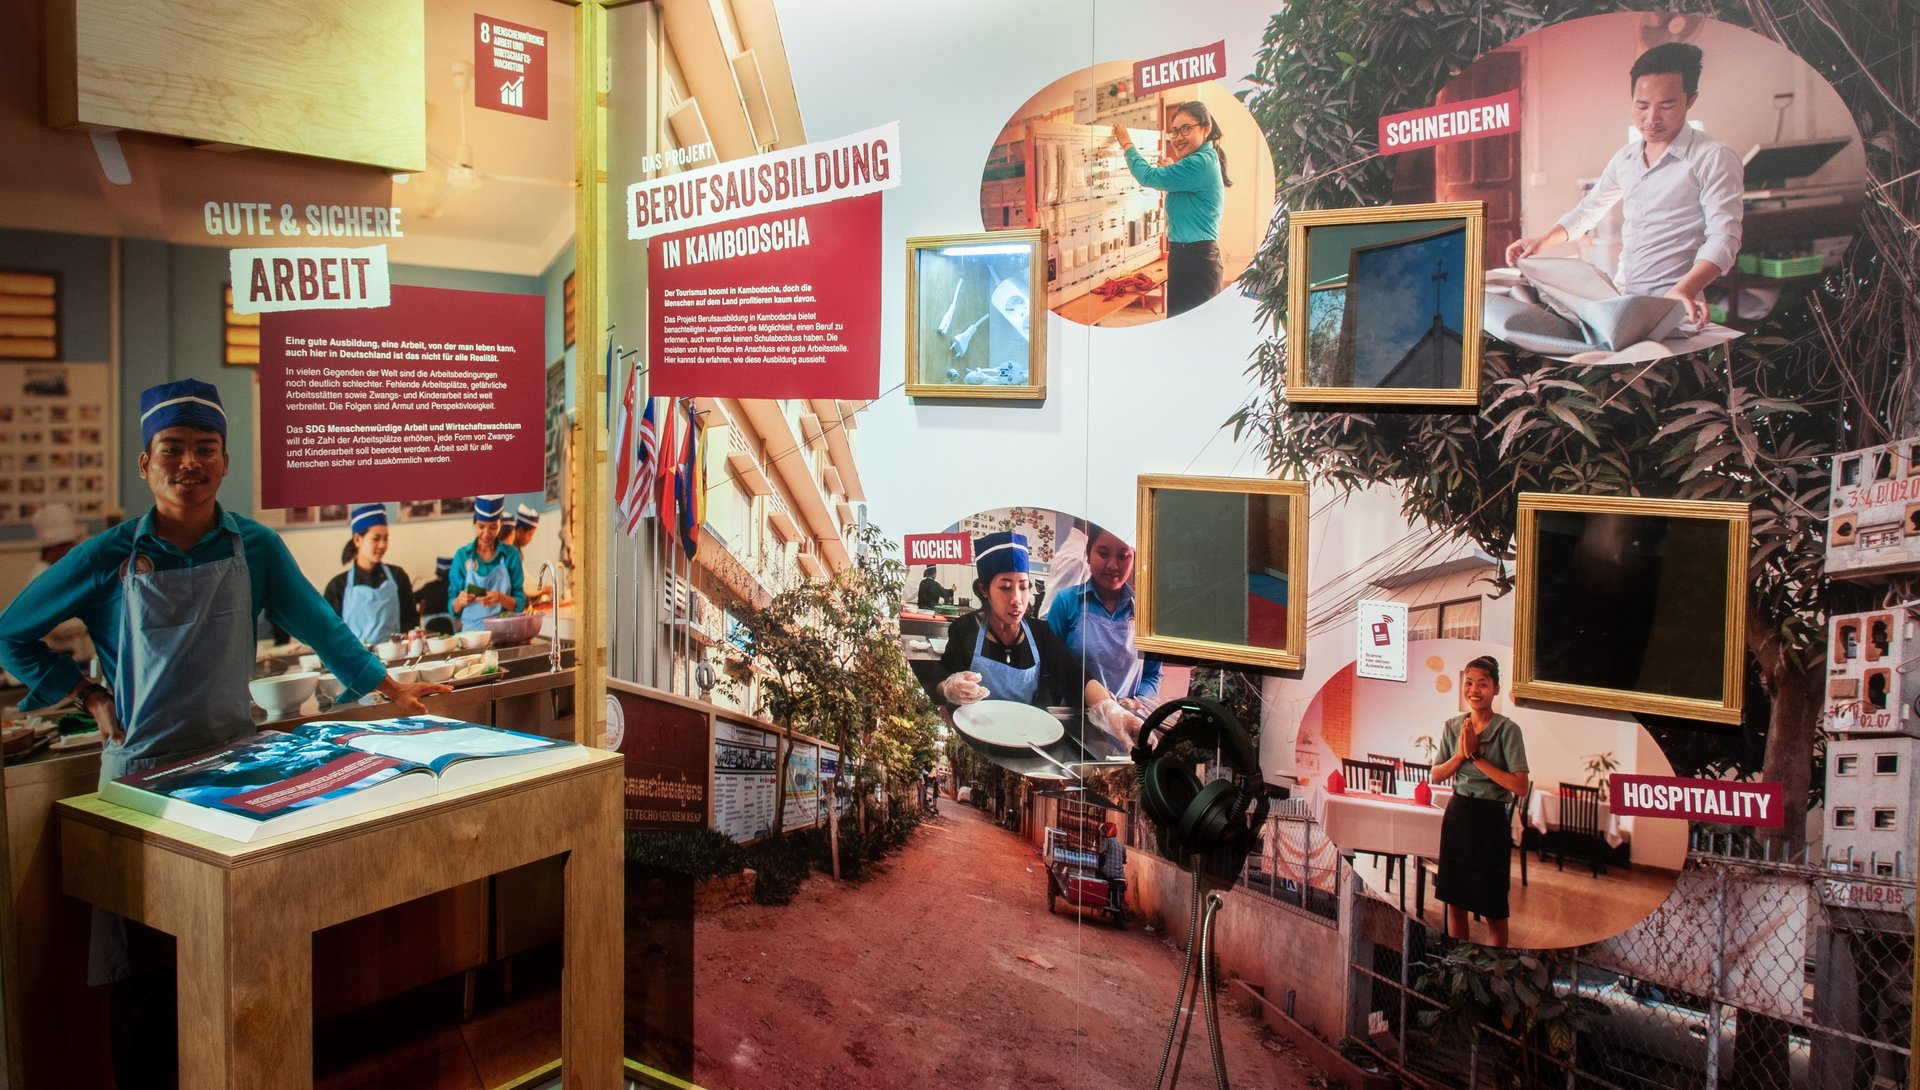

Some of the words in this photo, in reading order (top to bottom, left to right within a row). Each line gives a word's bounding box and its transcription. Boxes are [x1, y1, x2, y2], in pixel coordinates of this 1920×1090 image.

[480, 22, 491, 44] 8
[1141, 52, 1217, 89] ELEKTRIK
[1386, 102, 1510, 147] SCHNEIDERN
[641, 153, 662, 174] DAS
[665, 141, 714, 168] PROJEKT
[635, 138, 890, 228] BERUFSAUSBILDUNG
[203, 201, 275, 237] GUTE
[279, 203, 301, 237] &
[306, 204, 404, 238] SICHERE
[662, 239, 681, 270] IN
[686, 216, 810, 266] KAMBODSCHA
[249, 257, 370, 303] ARBEIT
[664, 289, 675, 297] Der
[676, 288, 708, 296] Tourismus
[708, 287, 728, 295] boomt
[730, 286, 736, 294] in
[782, 284, 800, 292] doch
[801, 283, 812, 292] die
[664, 299, 695, 307] Menschen
[696, 298, 706, 306] auf
[707, 298, 721, 306] dem
[722, 297, 738, 305] Land
[739, 296, 772, 306] profitieren
[774, 295, 792, 303] kaum
[664, 315, 676, 323] Das
[677, 315, 697, 324] Projekt
[698, 314, 748, 323] Berufsausbildung
[757, 313, 797, 321] Kambodscha
[798, 312, 816, 320] bietet
[708, 323, 746, 334] Jugendlichen
[748, 324, 757, 332] die
[796, 323, 814, 331] einen
[816, 322, 834, 330] Beruf
[286, 336, 306, 345] Eine
[308, 338, 328, 347] gute
[330, 338, 380, 349] Ausbildung,
[381, 340, 399, 348] eine
[401, 341, 427, 350] Arbeit,
[444, 342, 457, 350] der
[476, 343, 496, 352] leben
[497, 344, 516, 353] kann,
[690, 335, 705, 343] auch
[723, 335, 732, 343] sie
[733, 335, 753, 343] keinen
[754, 334, 802, 342] Schulabschluss
[827, 333, 838, 341] Die
[286, 348, 308, 357] auch
[310, 349, 327, 357] hier
[329, 349, 338, 357] in
[340, 349, 392, 359] Deutschland
[393, 351, 404, 359] ist
[405, 352, 420, 360] das
[422, 352, 441, 360] nicht
[442, 352, 454, 361] für
[455, 353, 468, 361] alle
[470, 353, 499, 362] Realität.
[745, 355, 762, 363] diese
[763, 355, 797, 365] Ausbildung
[286, 367, 294, 375] In
[296, 368, 321, 376] vielen
[323, 367, 364, 378] Gegenden
[366, 369, 380, 377] der
[381, 369, 398, 377] Welt
[400, 369, 415, 377] sind
[417, 369, 428, 378] die
[430, 370, 498, 380] Arbeitsbedingungen
[286, 379, 306, 387] noch
[309, 379, 340, 387] deutlich
[342, 380, 384, 388] schlechter.
[386, 380, 420, 388] Fehlende
[422, 380, 469, 389] Arbeitsplätze,
[471, 380, 507, 390] gefährliche
[286, 390, 342, 399] Arbeitsstätten
[345, 391, 367, 399] sowie
[369, 390, 402, 401] Zwangs-
[404, 391, 418, 399] und
[419, 391, 462, 399] Kinderarbeit
[463, 390, 478, 399] sind
[286, 402, 327, 410] verbreitet.
[330, 401, 343, 410] Die
[345, 401, 372, 412] Folgen
[374, 402, 390, 410] sind
[392, 402, 414, 410] Armut
[416, 402, 430, 410] und
[431, 402, 496, 411] Perspektivlosigkeit.
[287, 425, 303, 433] Das
[306, 424, 325, 433] SDG
[328, 424, 402, 433] Menschenwürdige
[404, 423, 428, 431] Arbeit
[430, 423, 444, 431] und
[445, 422, 522, 430] Wirtschaftswachstum
[287, 437, 300, 445] will
[302, 437, 315, 445] die
[317, 436, 335, 444] Zahl
[337, 436, 351, 444] der
[353, 435, 402, 444] Arbeitsplätze
[404, 434, 436, 442] erhöhen,
[438, 434, 453, 443] jede
[454, 433, 472, 441] Form
[488, 432, 515, 441] Zwangs-
[287, 448, 302, 457] und
[305, 447, 354, 456] Kinderarbeit
[356, 446, 369, 455] soll
[371, 446, 402, 454] beendet
[404, 445, 432, 453] werden.
[434, 444, 455, 452] Arbeit
[456, 443, 468, 452] soll
[470, 443, 479, 451] für
[480, 443, 493, 451] alle
[287, 459, 329, 468] Menschen
[331, 458, 356, 467] sicher
[358, 457, 372, 466] und
[374, 456, 422, 465] auskömmlich
[424, 455, 452, 463] werden.
[911, 539, 963, 560] KOCHEN
[1623, 782, 1771, 819] HOSPITALITY
[634, 808, 659, 821] TECHO
[659, 810, 671, 822] SEN
[671, 811, 686, 823] SIEM
[686, 812, 702, 823] REAP
